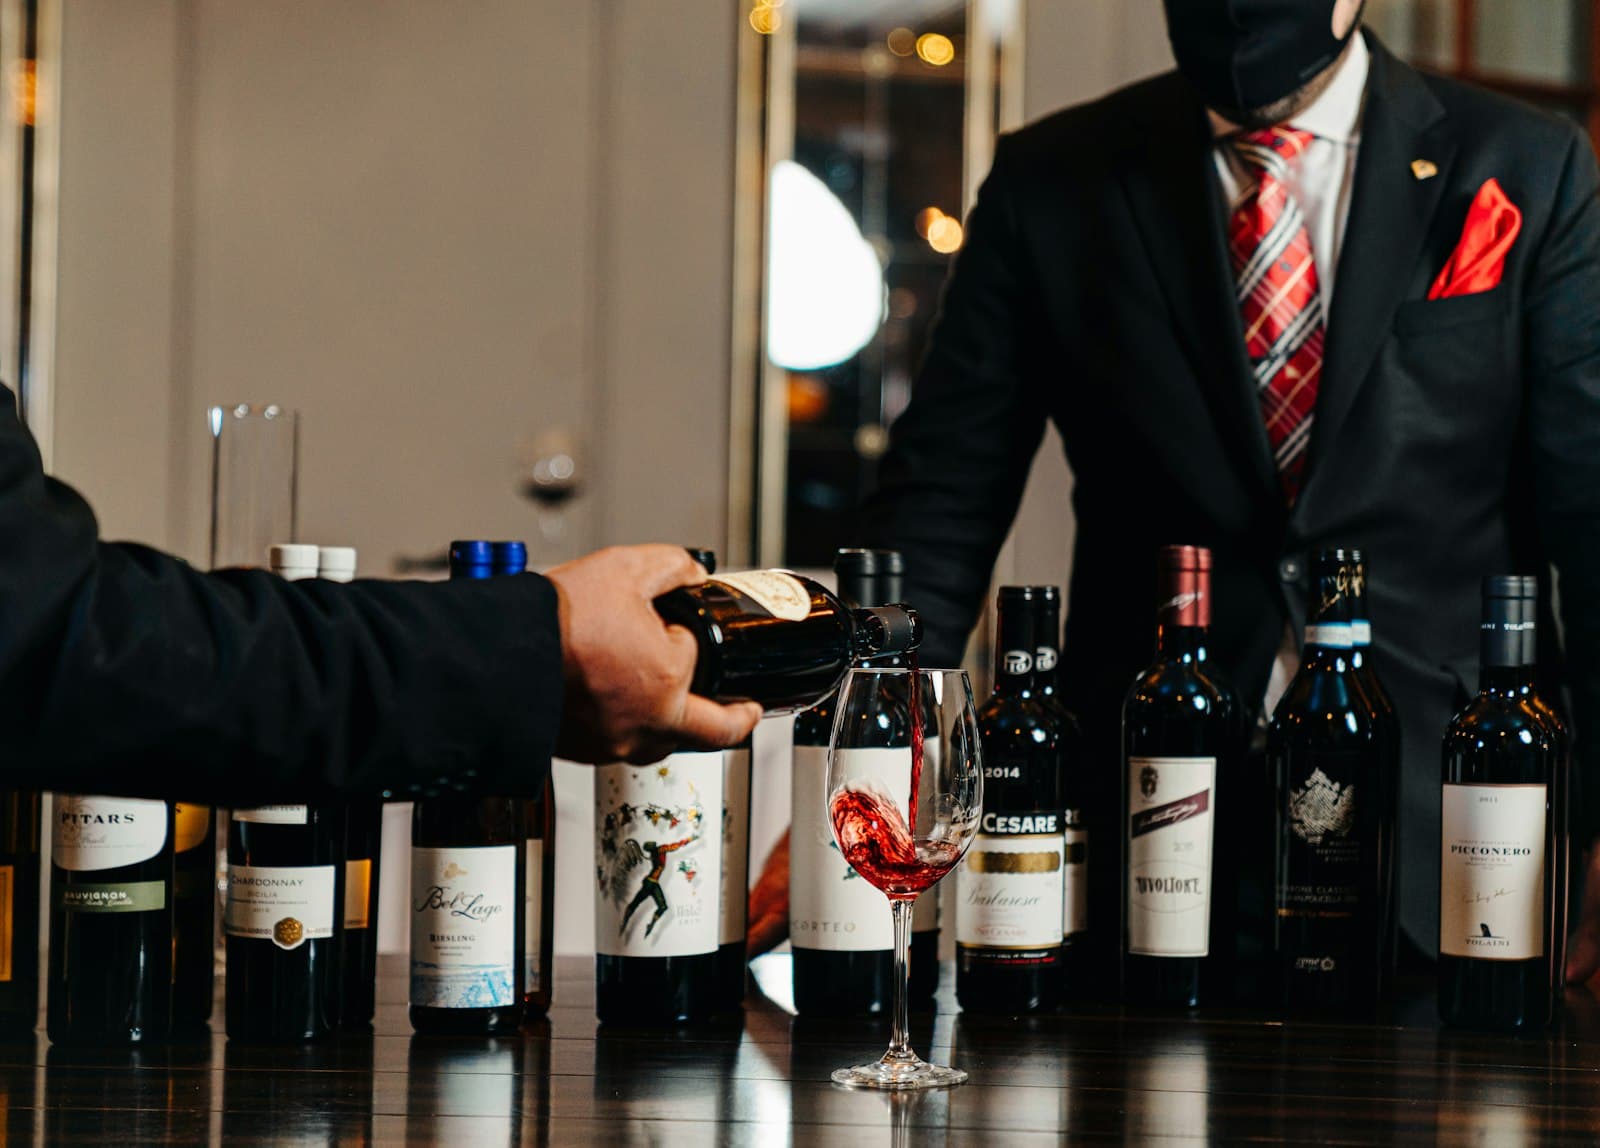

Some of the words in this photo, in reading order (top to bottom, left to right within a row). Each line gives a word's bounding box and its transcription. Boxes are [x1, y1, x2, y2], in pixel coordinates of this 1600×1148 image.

[985, 766, 1020, 779] 2014
[61, 813, 136, 826] PITARS
[982, 812, 1058, 834] CESARE
[1451, 845, 1533, 857] PICCONERO
[231, 875, 305, 888] CHARDONNAY
[64, 891, 128, 901] SAUVIGNON
[451, 893, 504, 924] Lago
[430, 934, 478, 943] RIESLING
